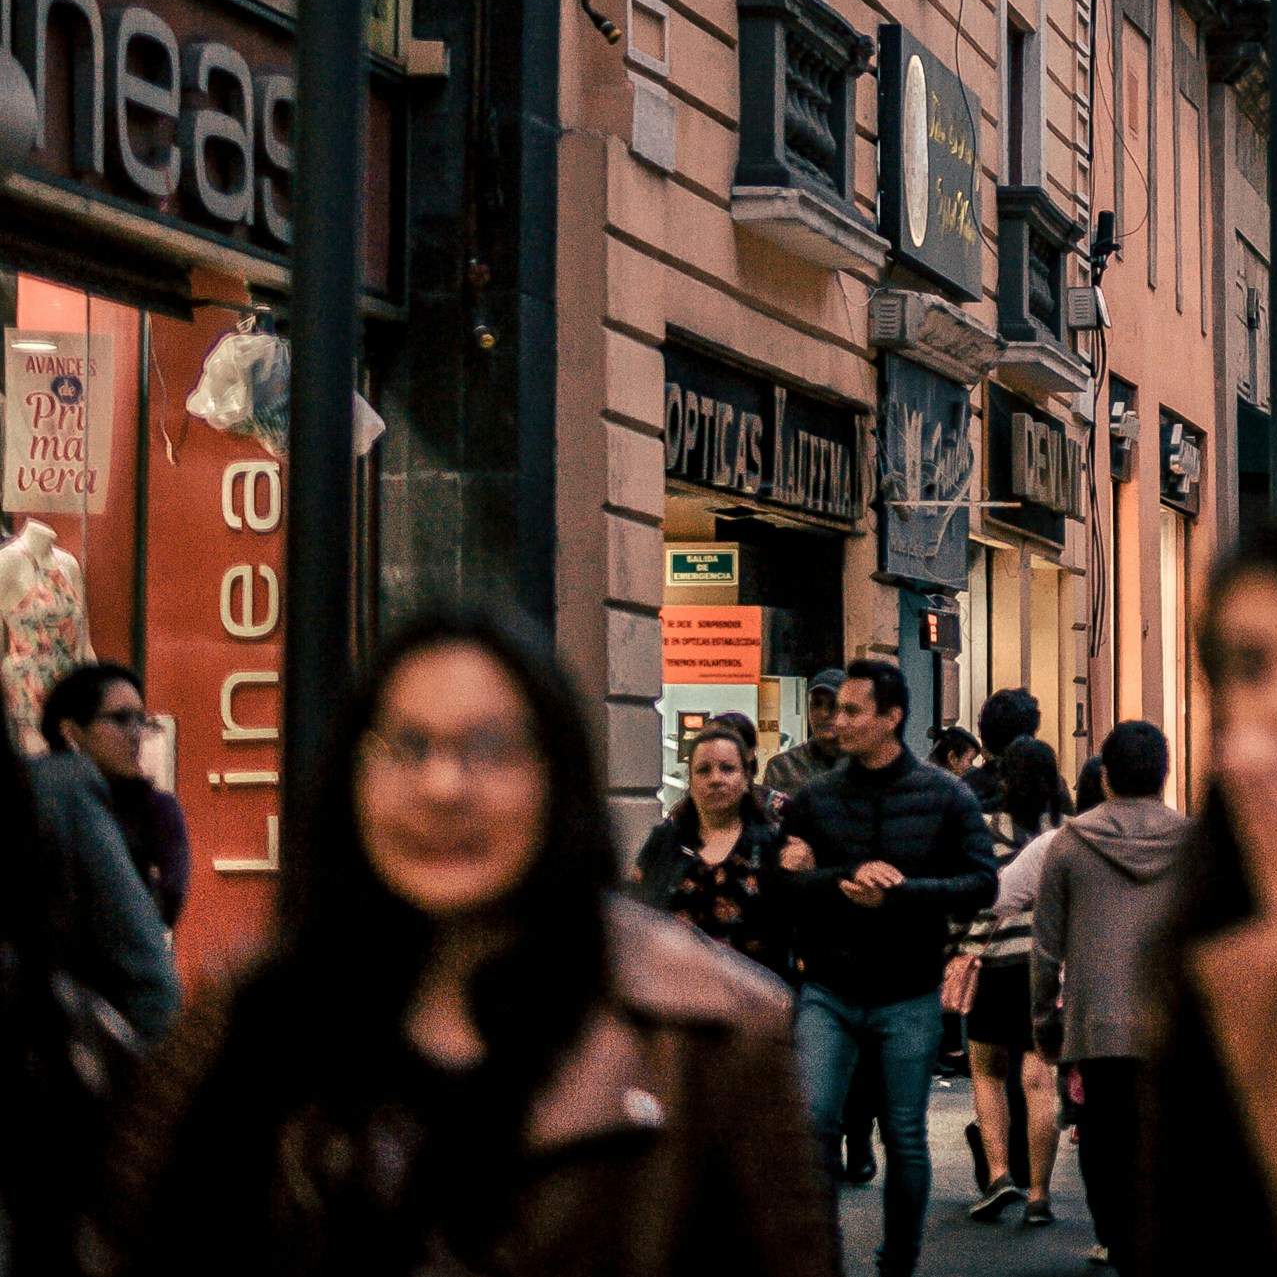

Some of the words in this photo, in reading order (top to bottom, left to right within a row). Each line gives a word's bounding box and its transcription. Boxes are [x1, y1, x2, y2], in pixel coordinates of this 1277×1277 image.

[26, 355, 96, 377] AVANCES
[26, 391, 85, 431] Pri
[30, 434, 84, 462] ma
[17, 466, 97, 495] vera
[686, 554, 719, 563] SALIDA
[696, 564, 709, 572] DE
[673, 572, 732, 580] EMERGENCIA
